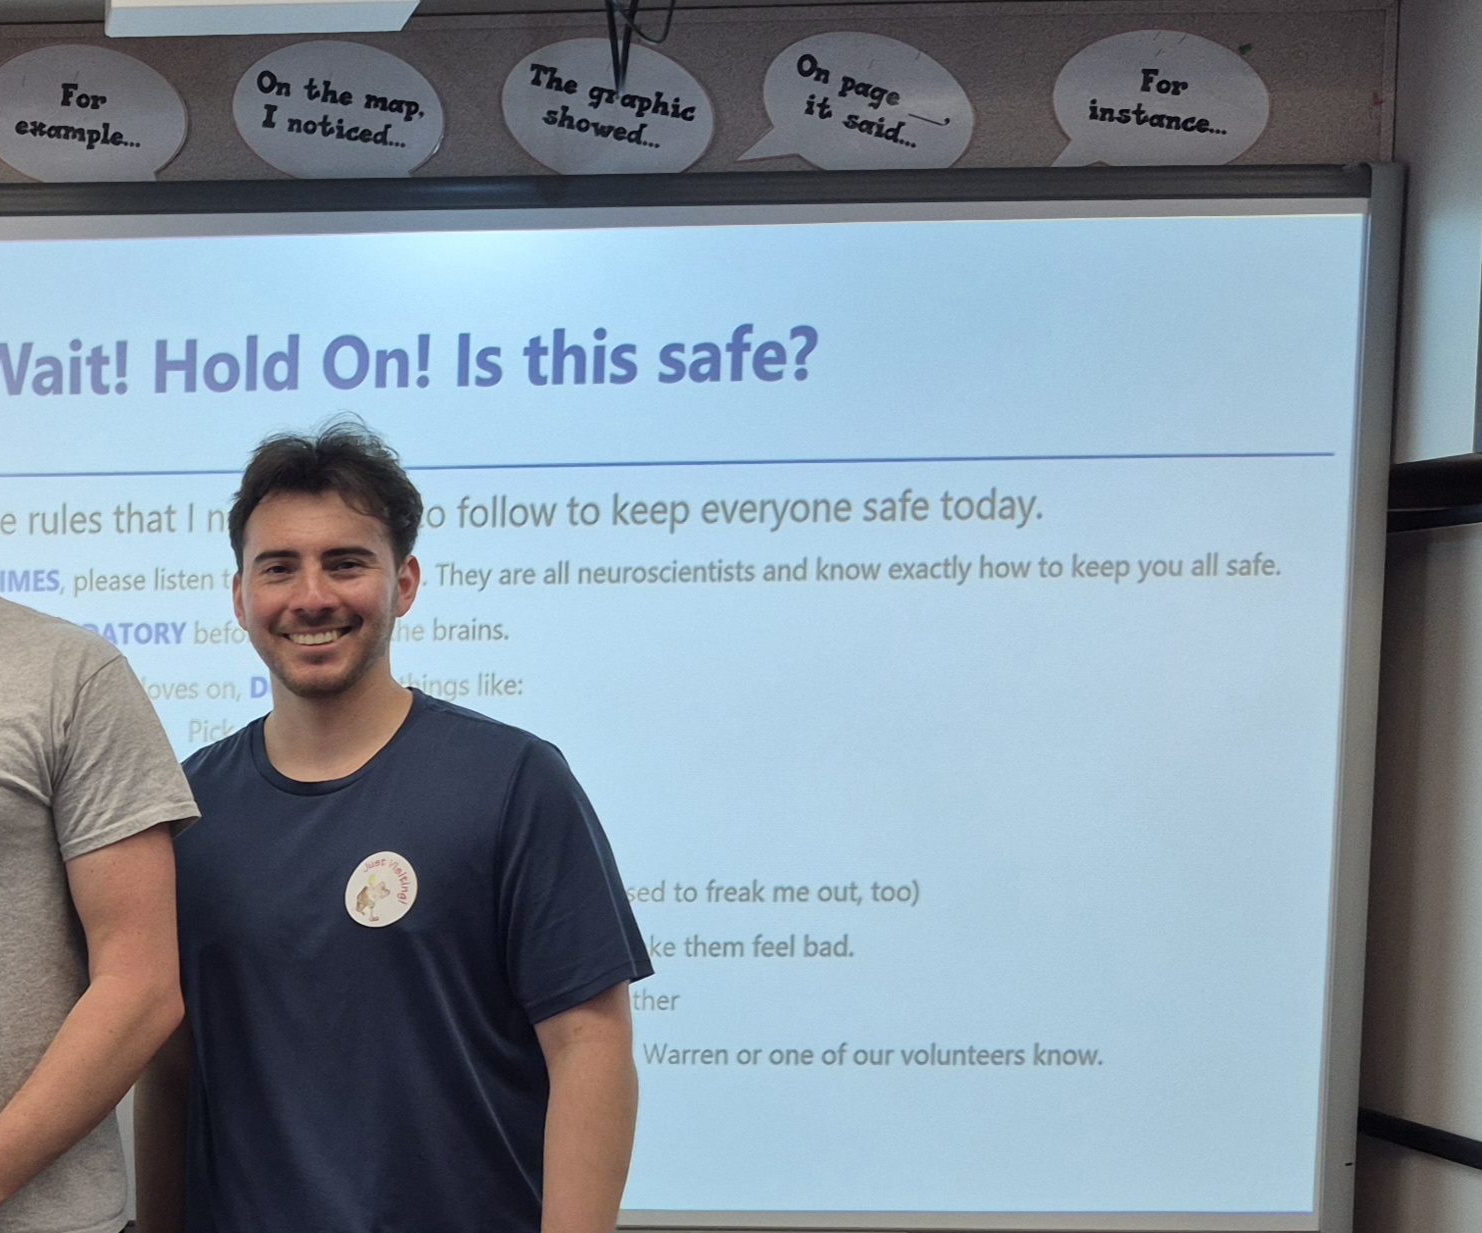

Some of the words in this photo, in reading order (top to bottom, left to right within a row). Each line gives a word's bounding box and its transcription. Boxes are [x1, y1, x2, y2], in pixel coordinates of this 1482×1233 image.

[61, 83, 107, 109] For
[257, 71, 291, 98] On
[303, 78, 353, 106] the
[364, 95, 425, 120] map,
[529, 64, 577, 95] The
[588, 83, 697, 123] graphic
[797, 54, 830, 84] On
[838, 75, 900, 109] page
[1140, 68, 1188, 96] For
[262, 105, 277, 129] I
[287, 114, 406, 148] noticed...
[542, 106, 660, 149] showed...
[804, 95, 832, 119] it
[842, 113, 917, 148] said...
[1089, 99, 1227, 135] instance...
[15, 119, 141, 150] example...
[154, 333, 300, 394] Hold
[322, 333, 431, 391] On!
[456, 333, 502, 387] Is
[523, 327, 637, 385] this
[658, 323, 818, 383] safe?
[28, 503, 102, 536] rules
[115, 503, 176, 534] that
[188, 503, 194, 532] I
[458, 493, 557, 528] follow
[567, 497, 599, 526] to
[611, 493, 689, 534] keep
[700, 497, 852, 532] everyone
[862, 488, 930, 523] safe
[941, 488, 1043, 528] today.
[74, 568, 146, 597] please
[154, 568, 221, 590] listen
[436, 563, 491, 591] They
[498, 567, 535, 586] are
[543, 561, 569, 584] all
[578, 560, 756, 585] neuroscientists
[763, 558, 807, 582] and
[816, 558, 880, 582] know
[888, 555, 971, 585] exactly
[979, 555, 1031, 580] how
[1039, 558, 1063, 579] to
[1072, 553, 1131, 584] keep
[1138, 558, 1182, 583] you
[1191, 553, 1218, 577] all
[1227, 552, 1281, 577] safe.
[433, 618, 509, 642] brains.
[477, 672, 523, 697] like:
[675, 882, 699, 902] to
[706, 879, 766, 902] freak
[773, 885, 810, 902] me
[817, 883, 863, 906] out,
[871, 880, 920, 907] too)
[684, 935, 744, 958] them
[753, 934, 795, 957] feel
[804, 934, 854, 958] bad.
[643, 1043, 728, 1066] Warren
[737, 1047, 762, 1066] or
[769, 1047, 814, 1066] one
[822, 1043, 848, 1066] of
[853, 1047, 894, 1066] our
[901, 1043, 1025, 1067] volunteers
[1032, 1043, 1103, 1066] know.
